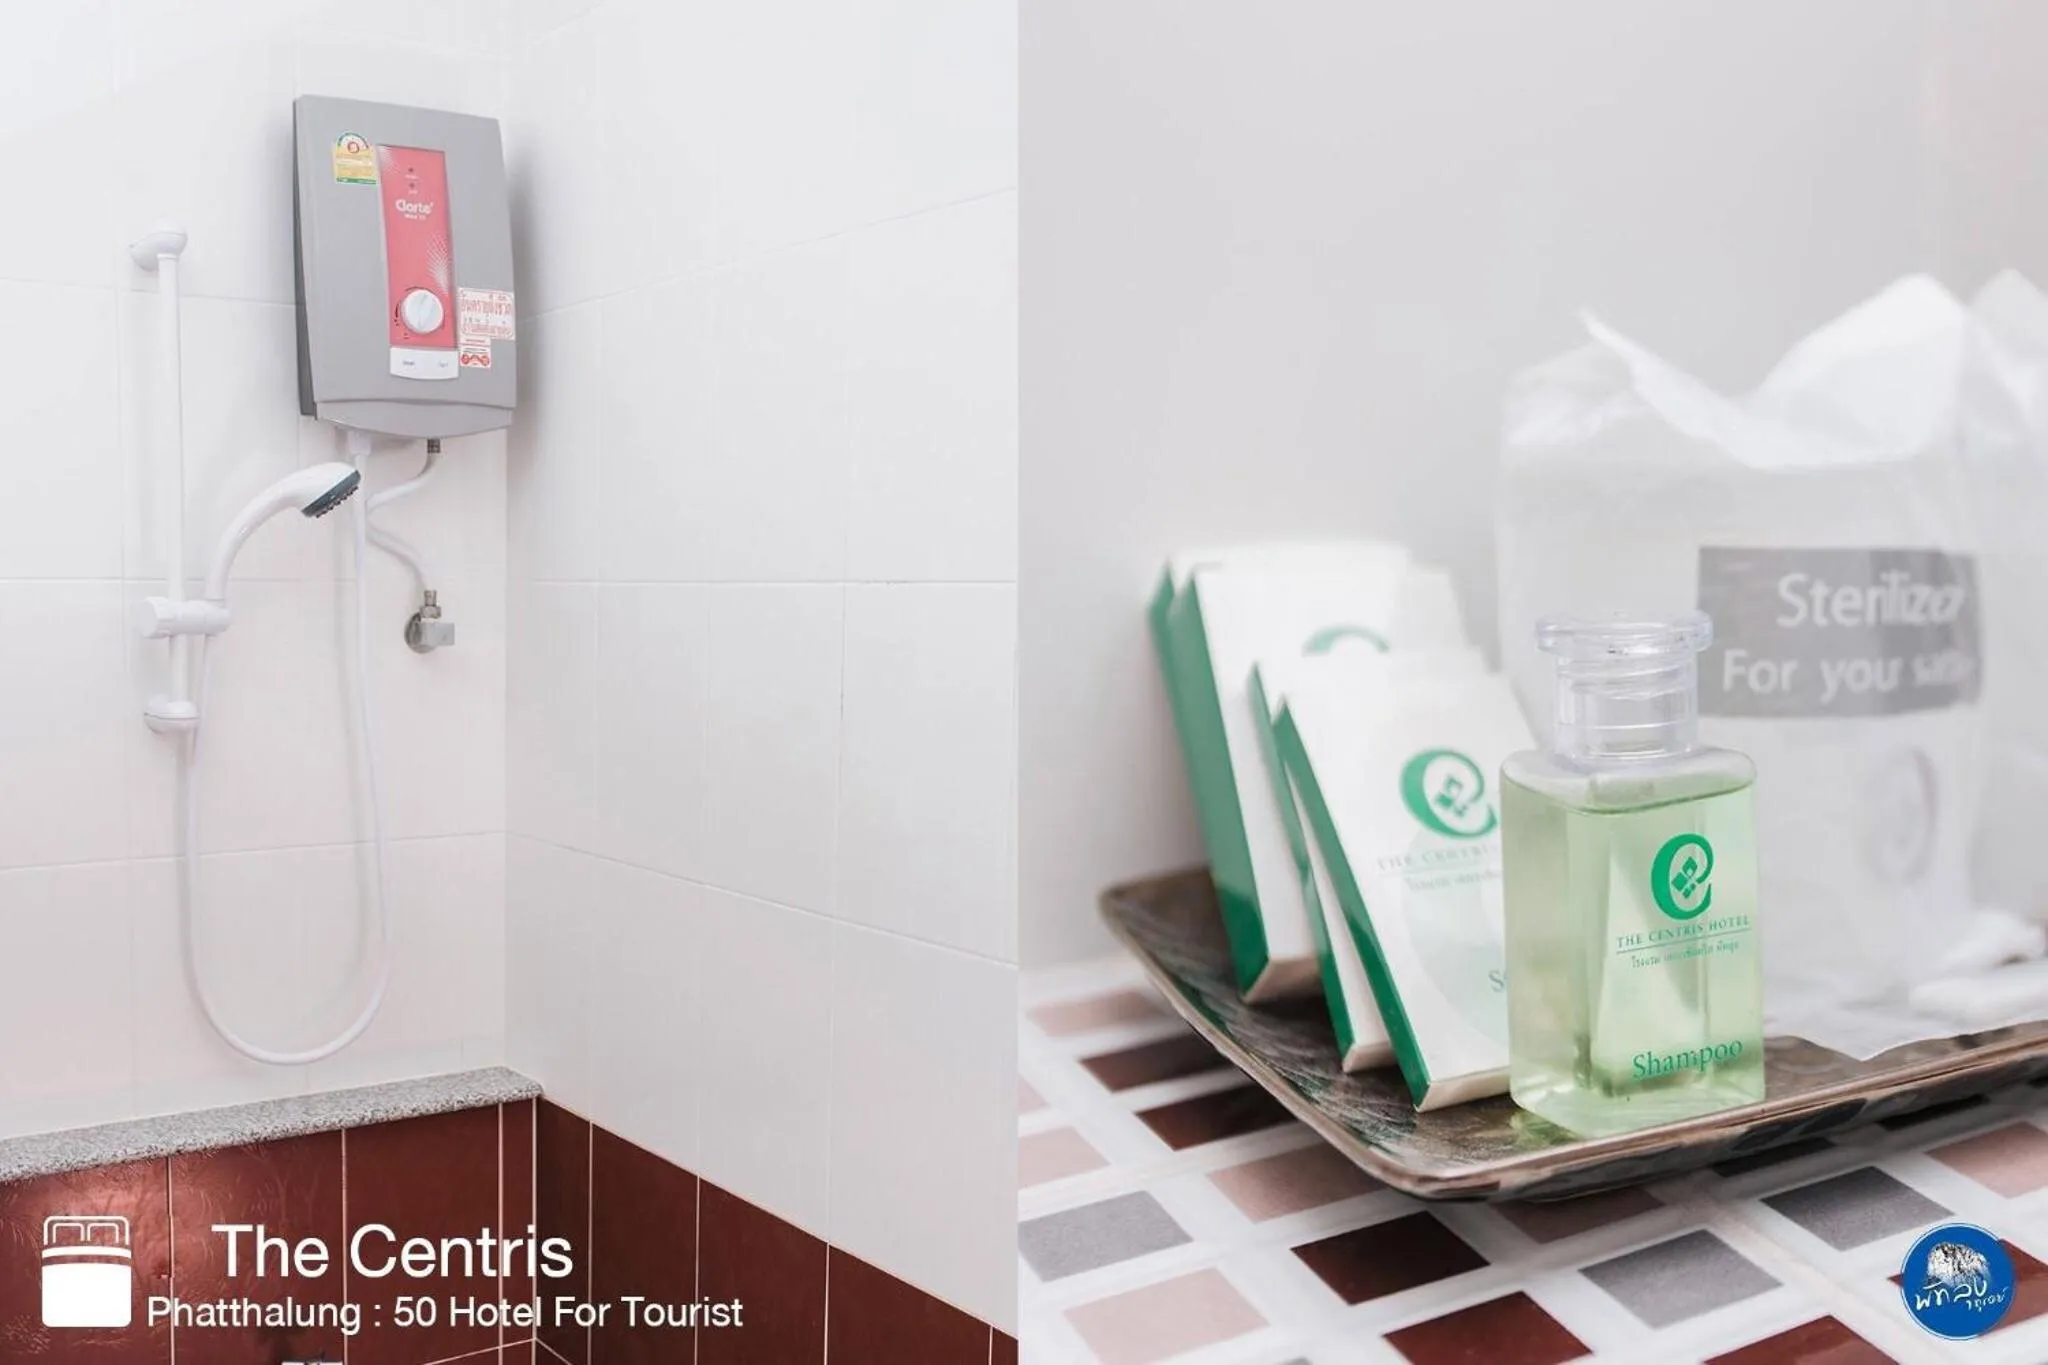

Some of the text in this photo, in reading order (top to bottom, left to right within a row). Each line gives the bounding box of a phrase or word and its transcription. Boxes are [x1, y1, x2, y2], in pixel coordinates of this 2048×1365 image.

[1723, 649, 1797, 694] For
[1819, 657, 1903, 703] you
[1617, 915, 1749, 948] THE CENTRIS HOTEL
[1633, 1040, 1743, 1078] Shampoo
